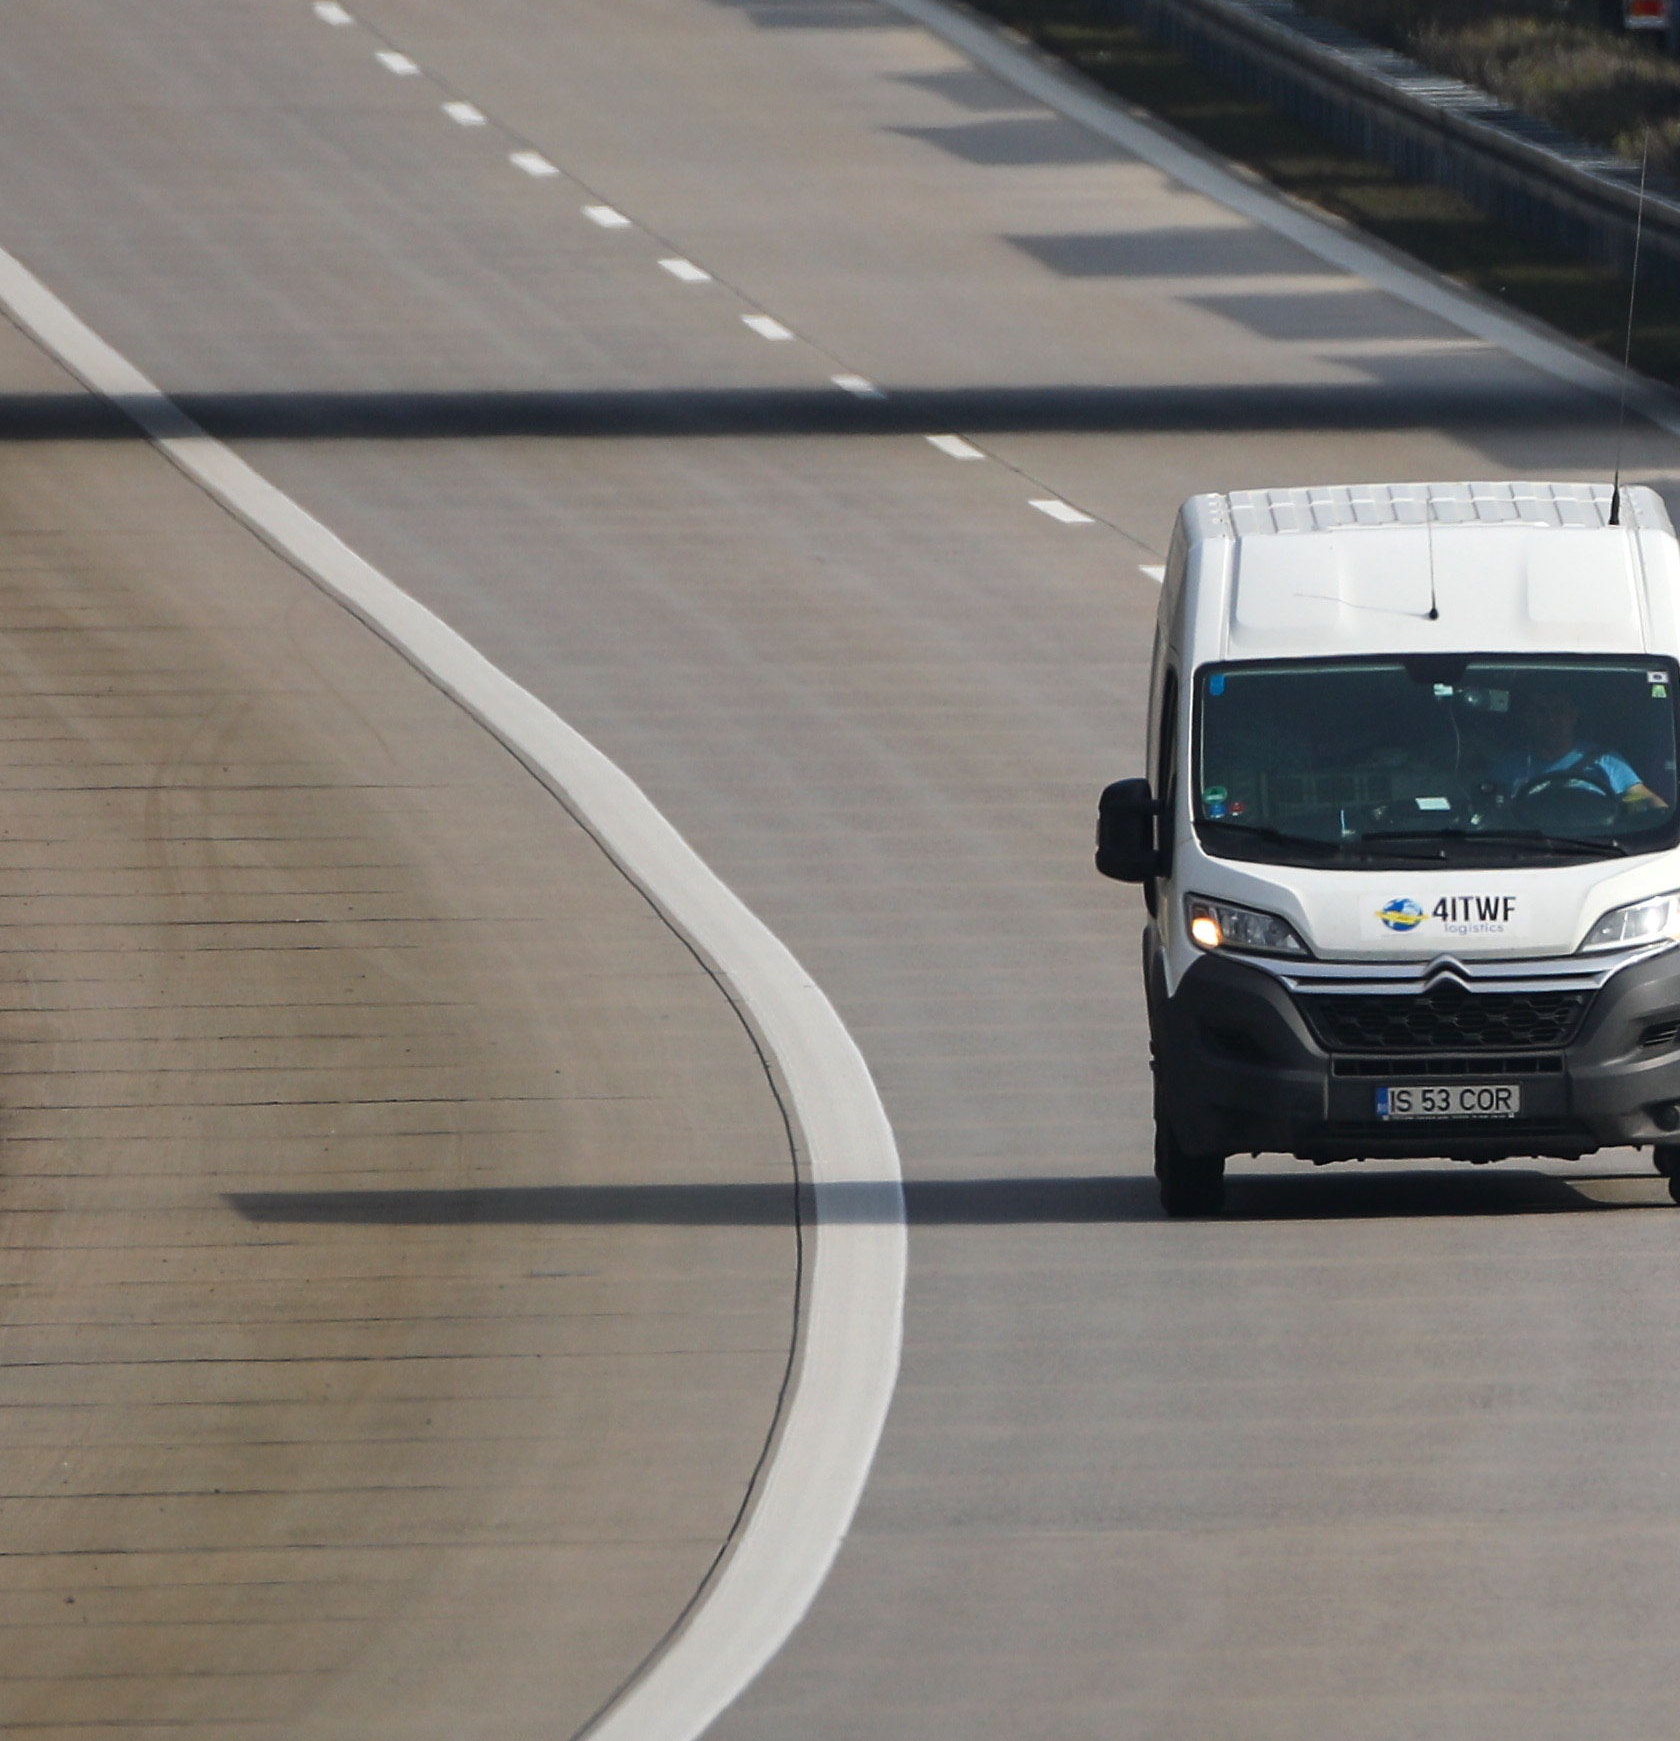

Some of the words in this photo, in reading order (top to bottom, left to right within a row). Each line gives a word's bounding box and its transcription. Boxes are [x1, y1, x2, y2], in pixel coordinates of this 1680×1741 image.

[1432, 896, 1517, 922] 4ITWF
[1444, 922, 1505, 935] logistics
[1390, 1089, 1413, 1112] IS
[1421, 1088, 1451, 1112] 53
[1459, 1087, 1513, 1111] COR
